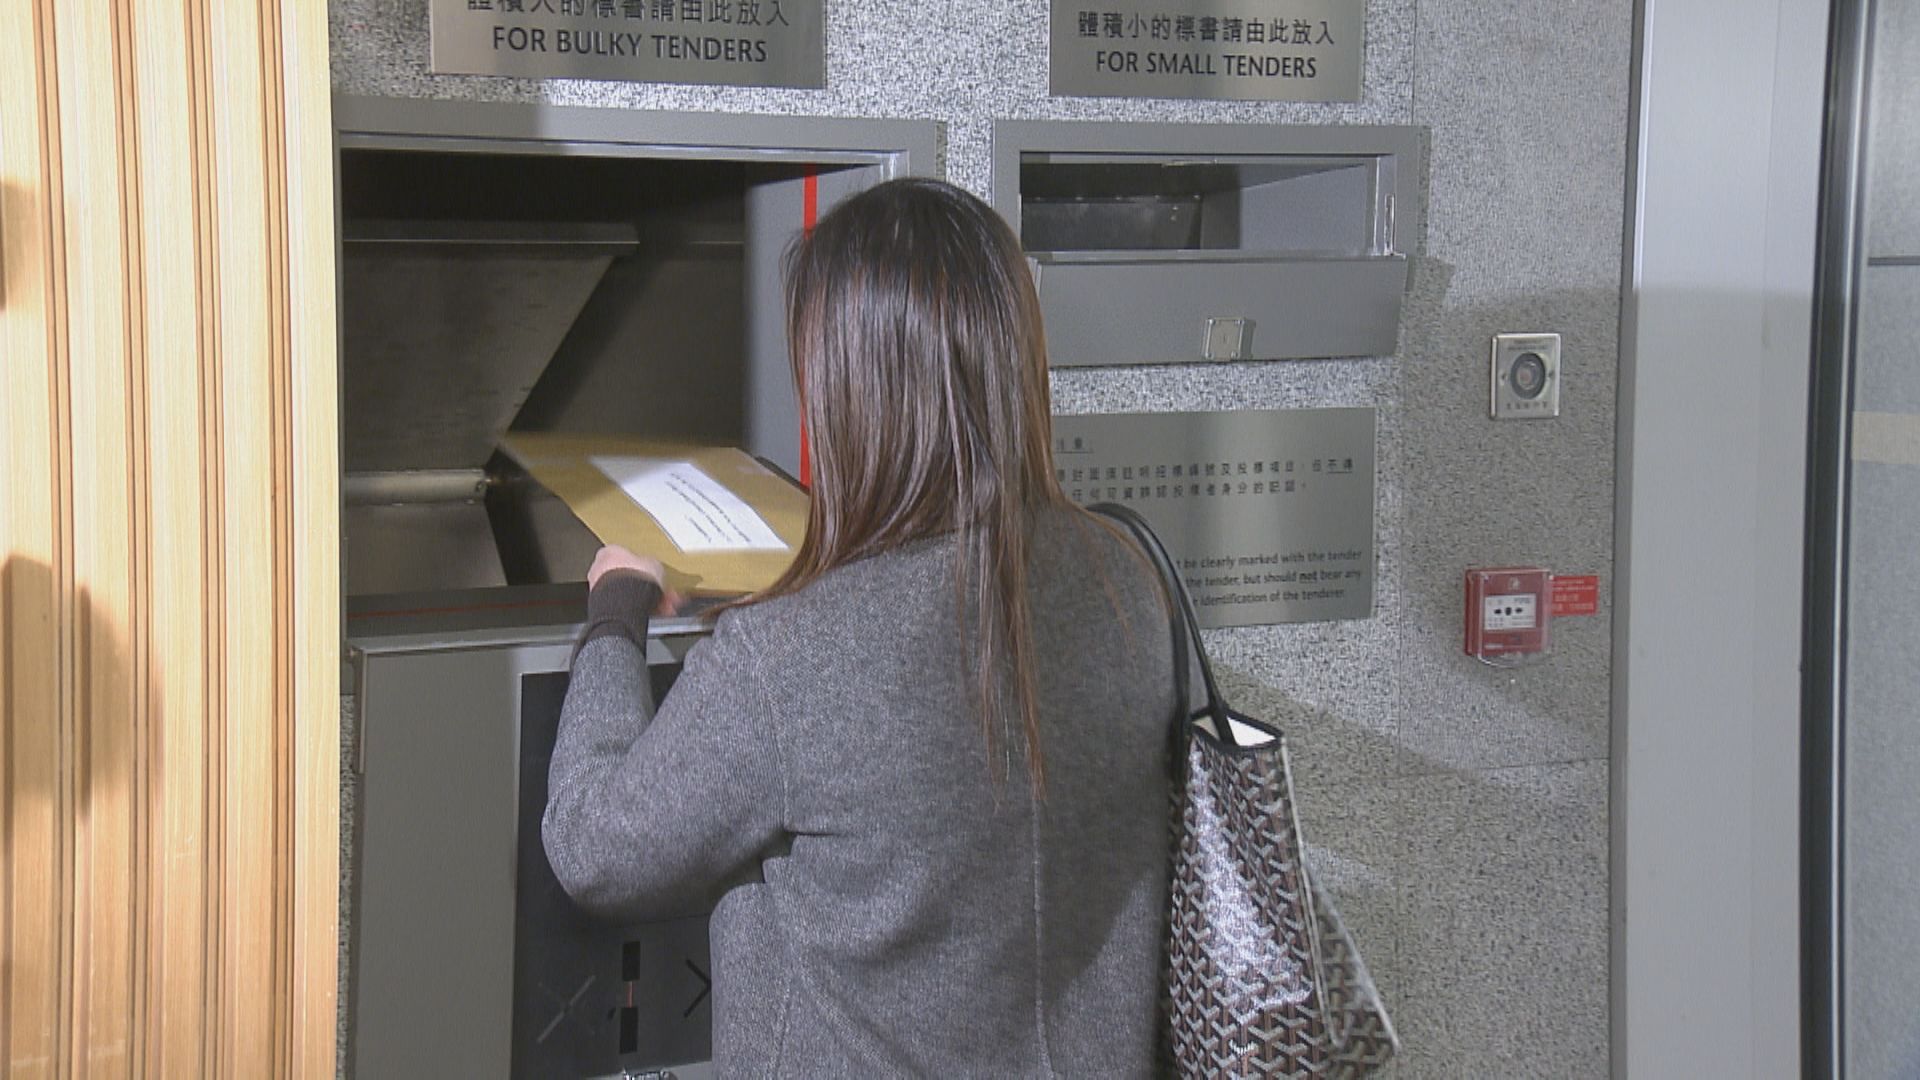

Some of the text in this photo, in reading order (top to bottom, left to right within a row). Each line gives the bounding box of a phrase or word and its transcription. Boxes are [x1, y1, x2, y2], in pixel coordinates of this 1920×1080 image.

[1078, 10, 1335, 45] 體積小的標書請由此放入
[493, 26, 767, 62] FOR BULKY TENDERS
[1096, 51, 1317, 78] FOR SMALL TENDERS
[1184, 558, 1197, 569] be
[1200, 556, 1234, 571] clearly
[1239, 553, 1278, 566] marked
[1281, 551, 1304, 563] with
[1307, 550, 1325, 562] the
[1327, 549, 1361, 562] tender
[1185, 576, 1202, 589] the
[1243, 573, 1261, 585] but
[1263, 570, 1297, 583] should
[1299, 570, 1317, 584] not
[1320, 569, 1342, 581] bear
[1345, 570, 1361, 582] any
[1200, 591, 1267, 606] identification
[1270, 589, 1281, 602] of
[1283, 589, 1298, 601] the
